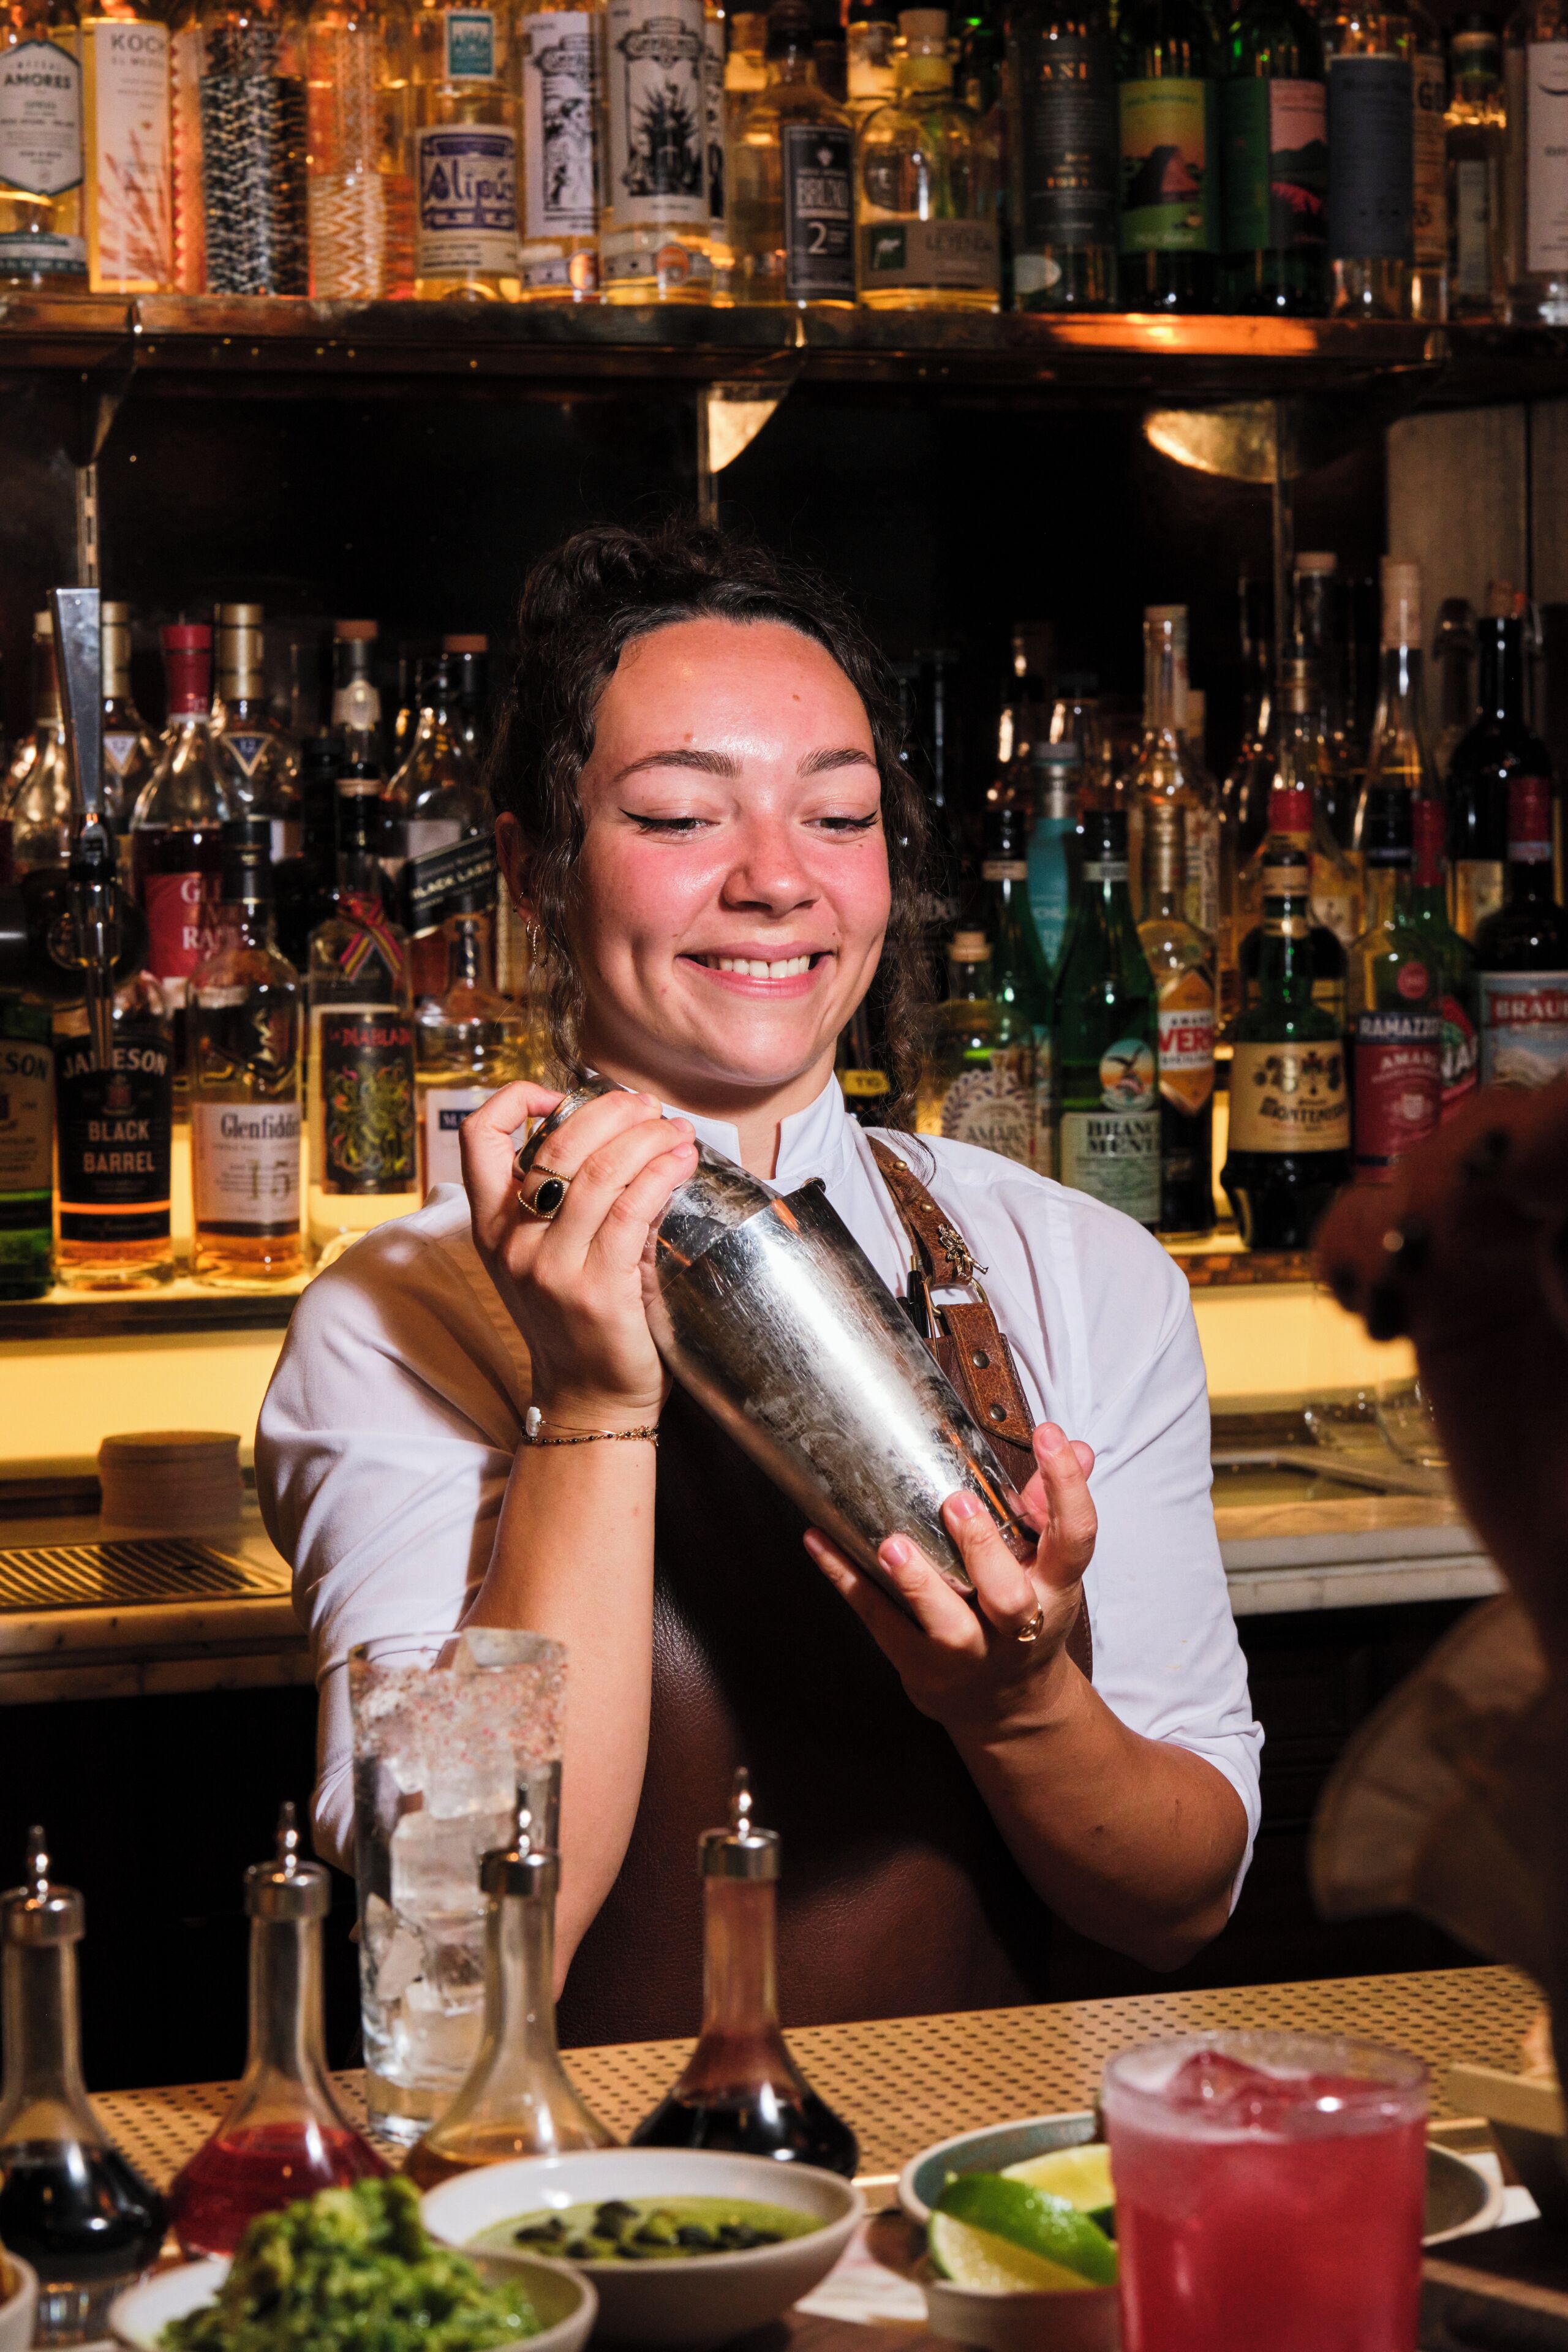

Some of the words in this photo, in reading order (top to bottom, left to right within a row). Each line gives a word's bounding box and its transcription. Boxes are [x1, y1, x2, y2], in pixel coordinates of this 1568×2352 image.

[807, 221, 828, 254] 2
[410, 874, 456, 900] BLACK
[88, 1119, 150, 1142] BLACK
[83, 1152, 156, 1173] BARREL
[247, 1159, 291, 1202] 15
